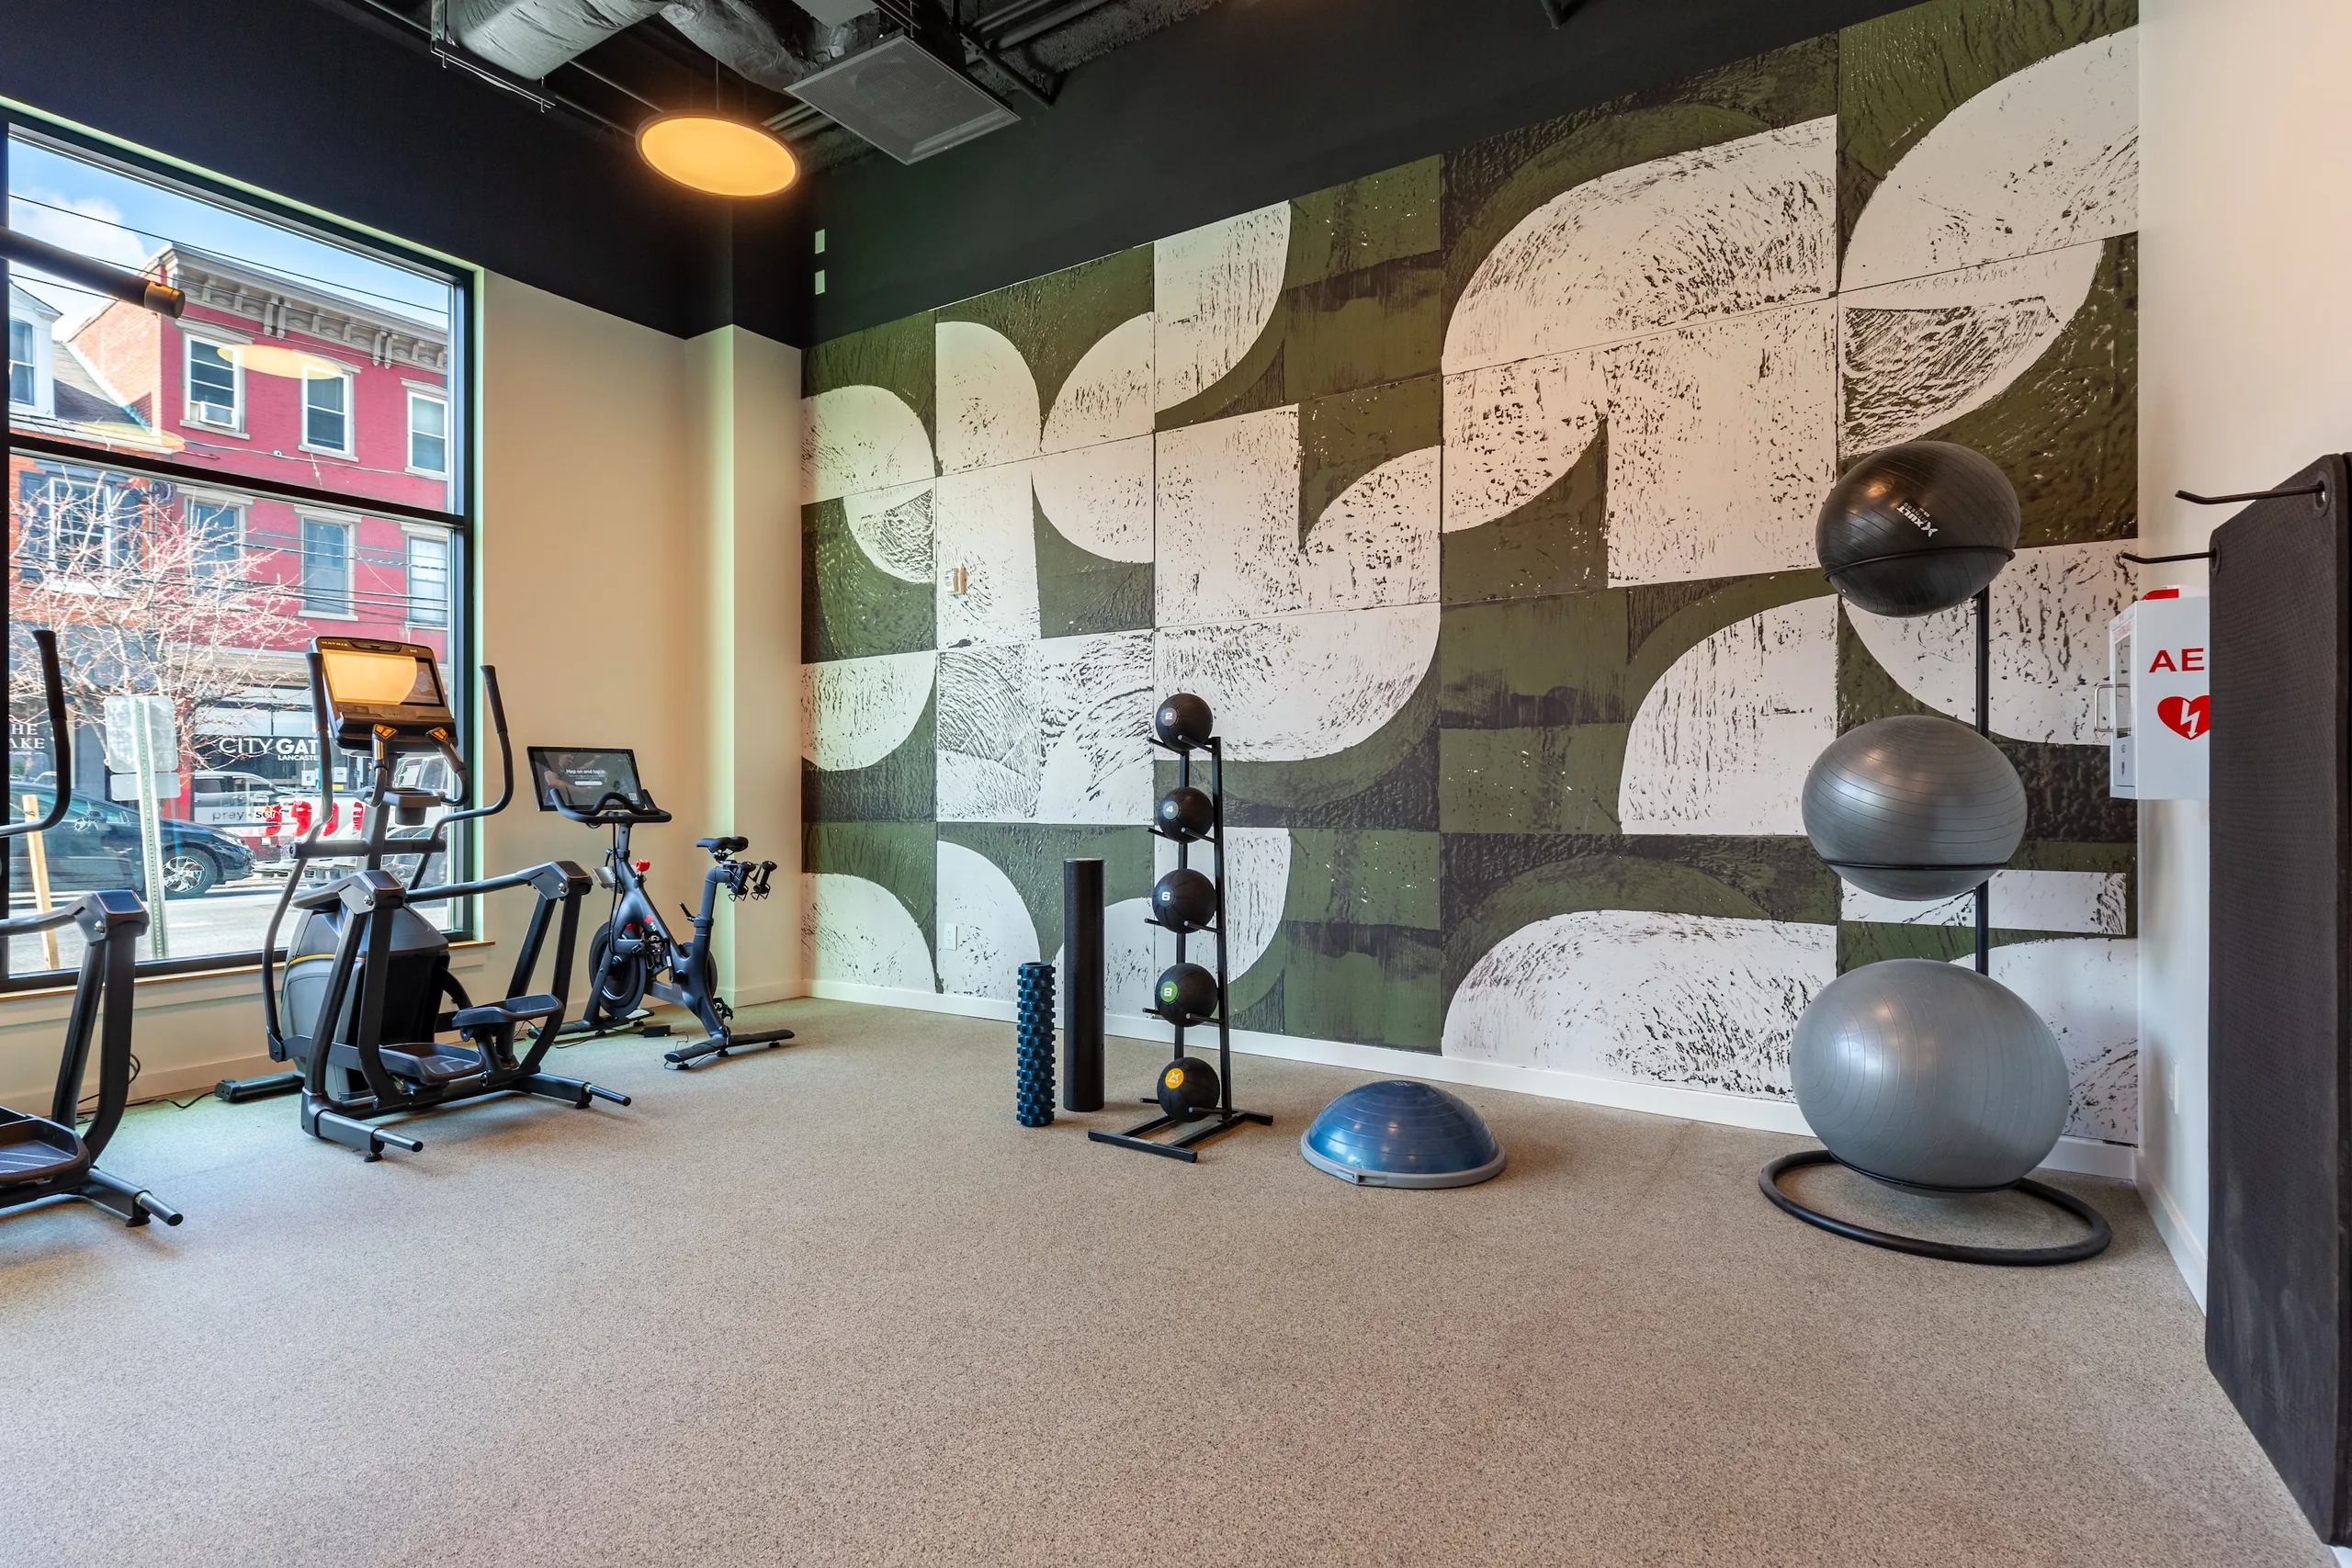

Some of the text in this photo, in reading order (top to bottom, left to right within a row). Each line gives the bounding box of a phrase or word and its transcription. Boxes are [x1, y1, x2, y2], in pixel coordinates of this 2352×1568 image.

[1896, 505, 1925, 528] XULT
[2148, 648, 2205, 673] AE
[1165, 712, 1173, 720] 2
[10, 724, 39, 735] HE
[9, 738, 45, 750] AKE
[219, 738, 319, 754] CITY GAT
[1166, 805, 1174, 813] 4
[212, 810, 244, 821] pray
[1161, 891, 1171, 901] 6
[1163, 987, 1173, 997] 8
